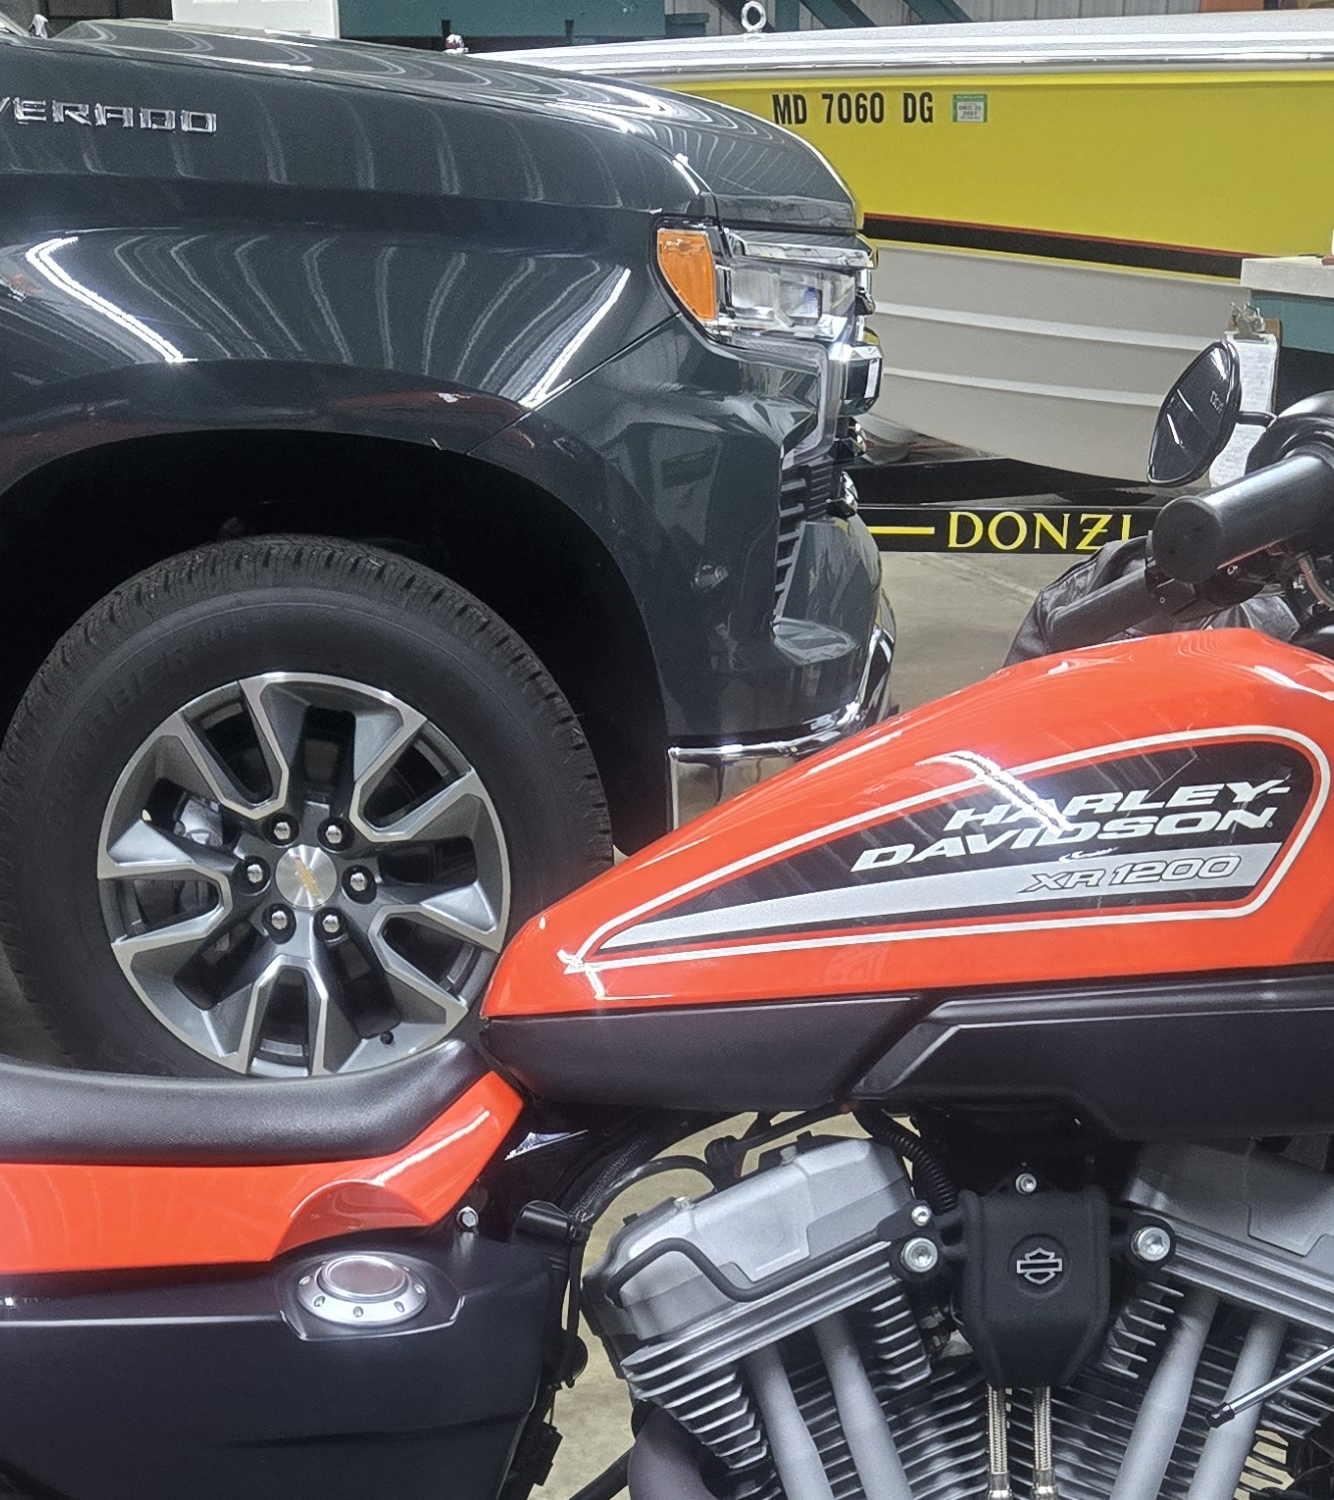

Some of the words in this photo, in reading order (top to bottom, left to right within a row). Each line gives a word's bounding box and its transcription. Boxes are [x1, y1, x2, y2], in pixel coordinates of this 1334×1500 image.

[772, 94, 807, 125] MD
[821, 92, 885, 124] 7060
[902, 91, 934, 124] DG
[947, 510, 1133, 551] DONZI
[850, 806, 1277, 873] DAVIDSON
